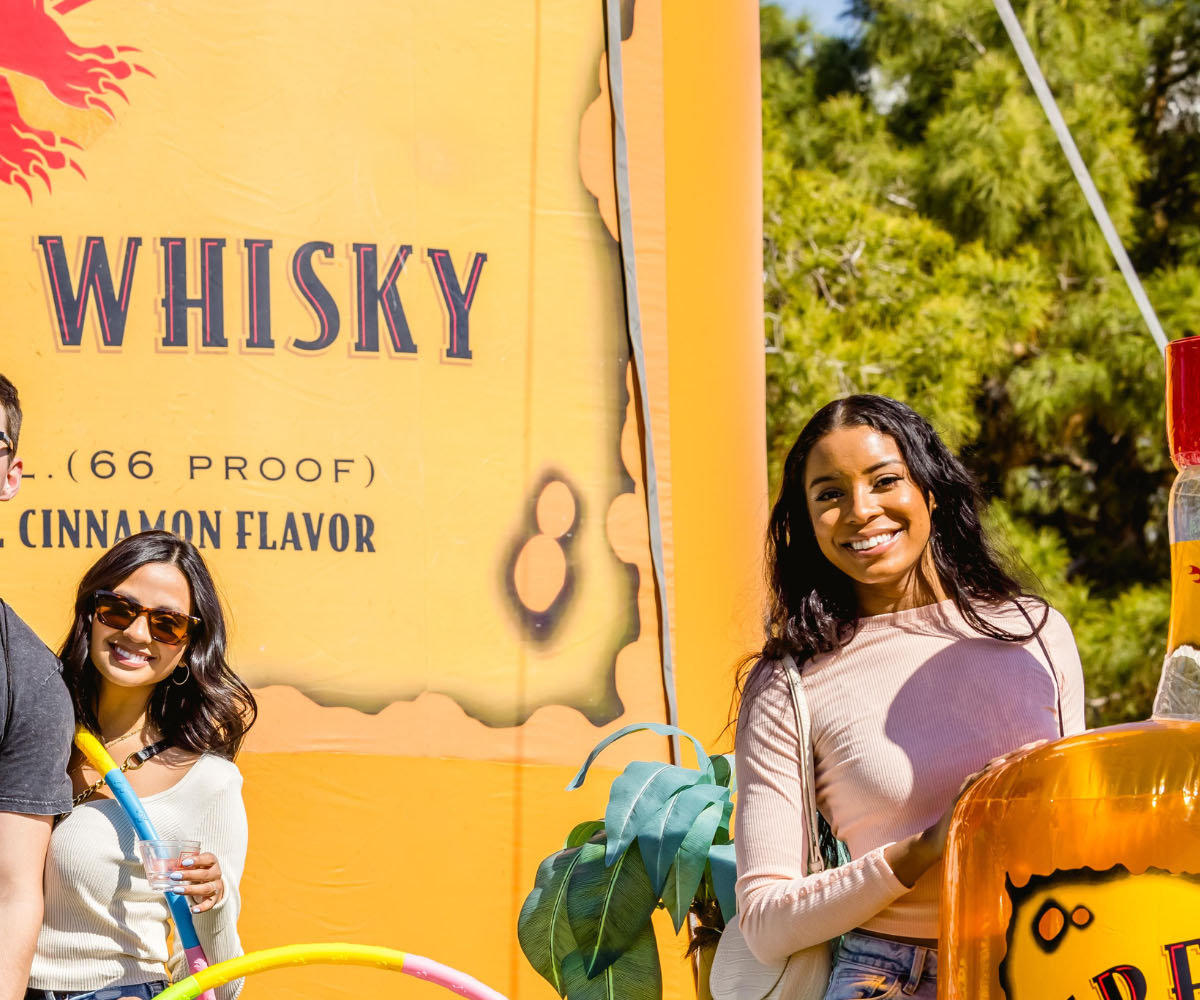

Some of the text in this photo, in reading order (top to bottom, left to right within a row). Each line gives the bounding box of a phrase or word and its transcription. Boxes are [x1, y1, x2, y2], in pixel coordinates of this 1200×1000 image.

[37, 235, 488, 361] WHISKY
[189, 454, 377, 488] PROOF)
[19, 509, 221, 550] CINNAMON
[236, 511, 376, 553] FLAVOR
